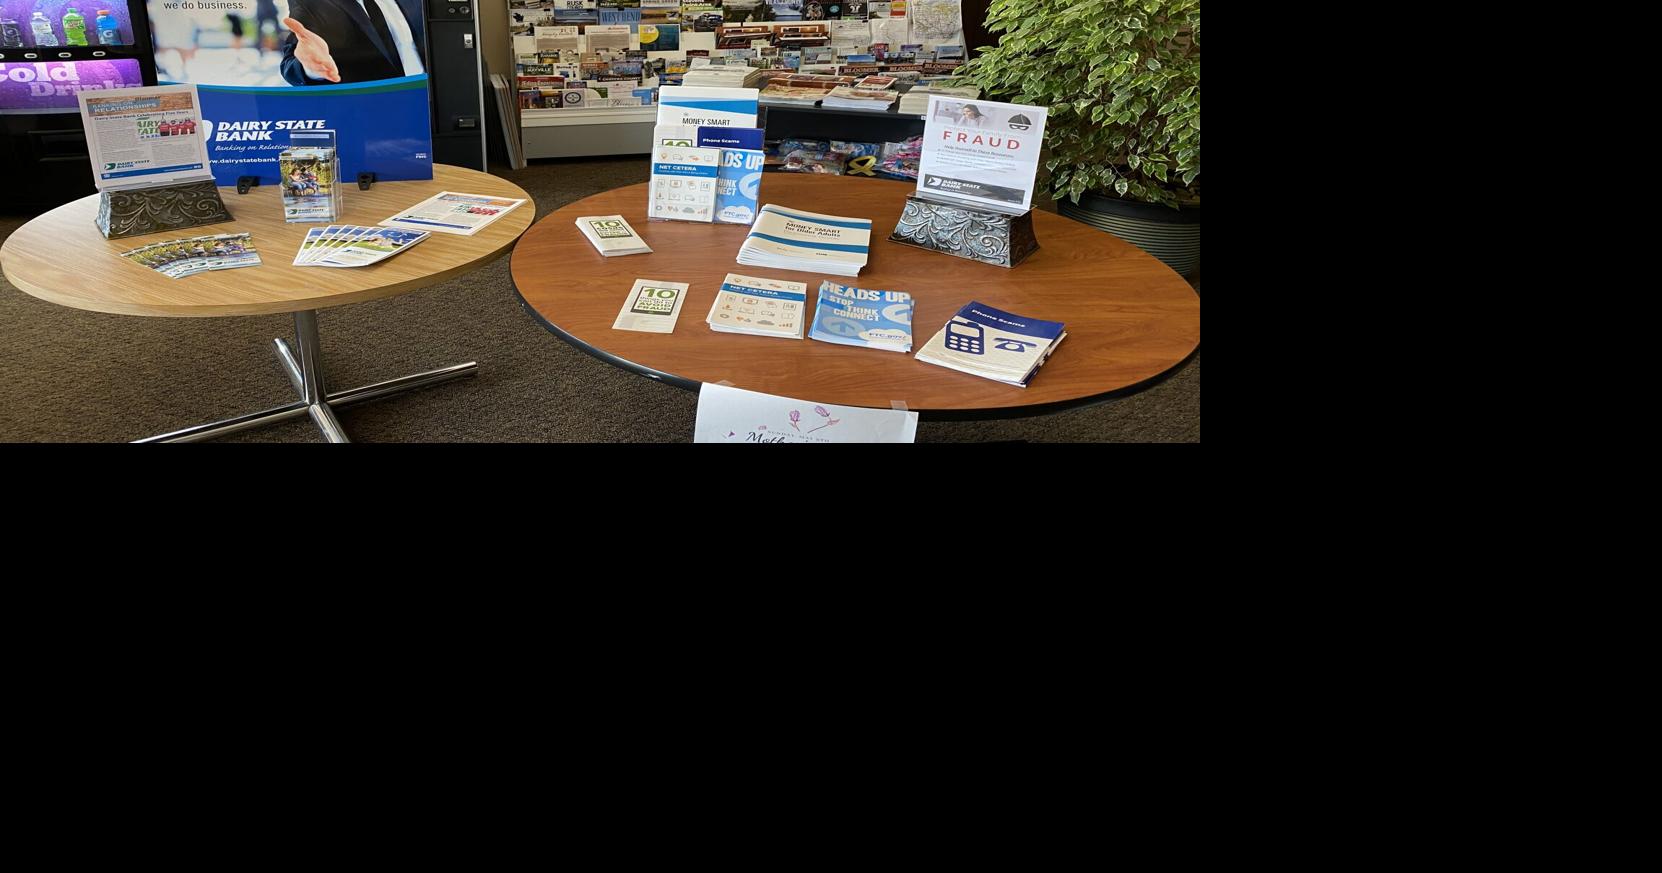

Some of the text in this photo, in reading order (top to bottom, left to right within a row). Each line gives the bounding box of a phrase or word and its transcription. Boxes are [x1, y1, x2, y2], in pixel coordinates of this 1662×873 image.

[163, 0, 248, 10] we do business.
[217, 119, 326, 131] DAIRY STATE
[682, 117, 731, 126] MONEY SMART
[215, 130, 274, 142] BANK
[943, 131, 1020, 150] FRAUD
[214, 144, 246, 153] Banking
[745, 155, 765, 170] UP
[786, 222, 813, 230] MONEY
[644, 288, 676, 299] 10
[822, 281, 911, 303] HEADS UP
[827, 295, 854, 306] STOP
[833, 309, 880, 322] CONNECT
[846, 304, 880, 317] THINK
[971, 309, 1026, 328] Phone Scams
